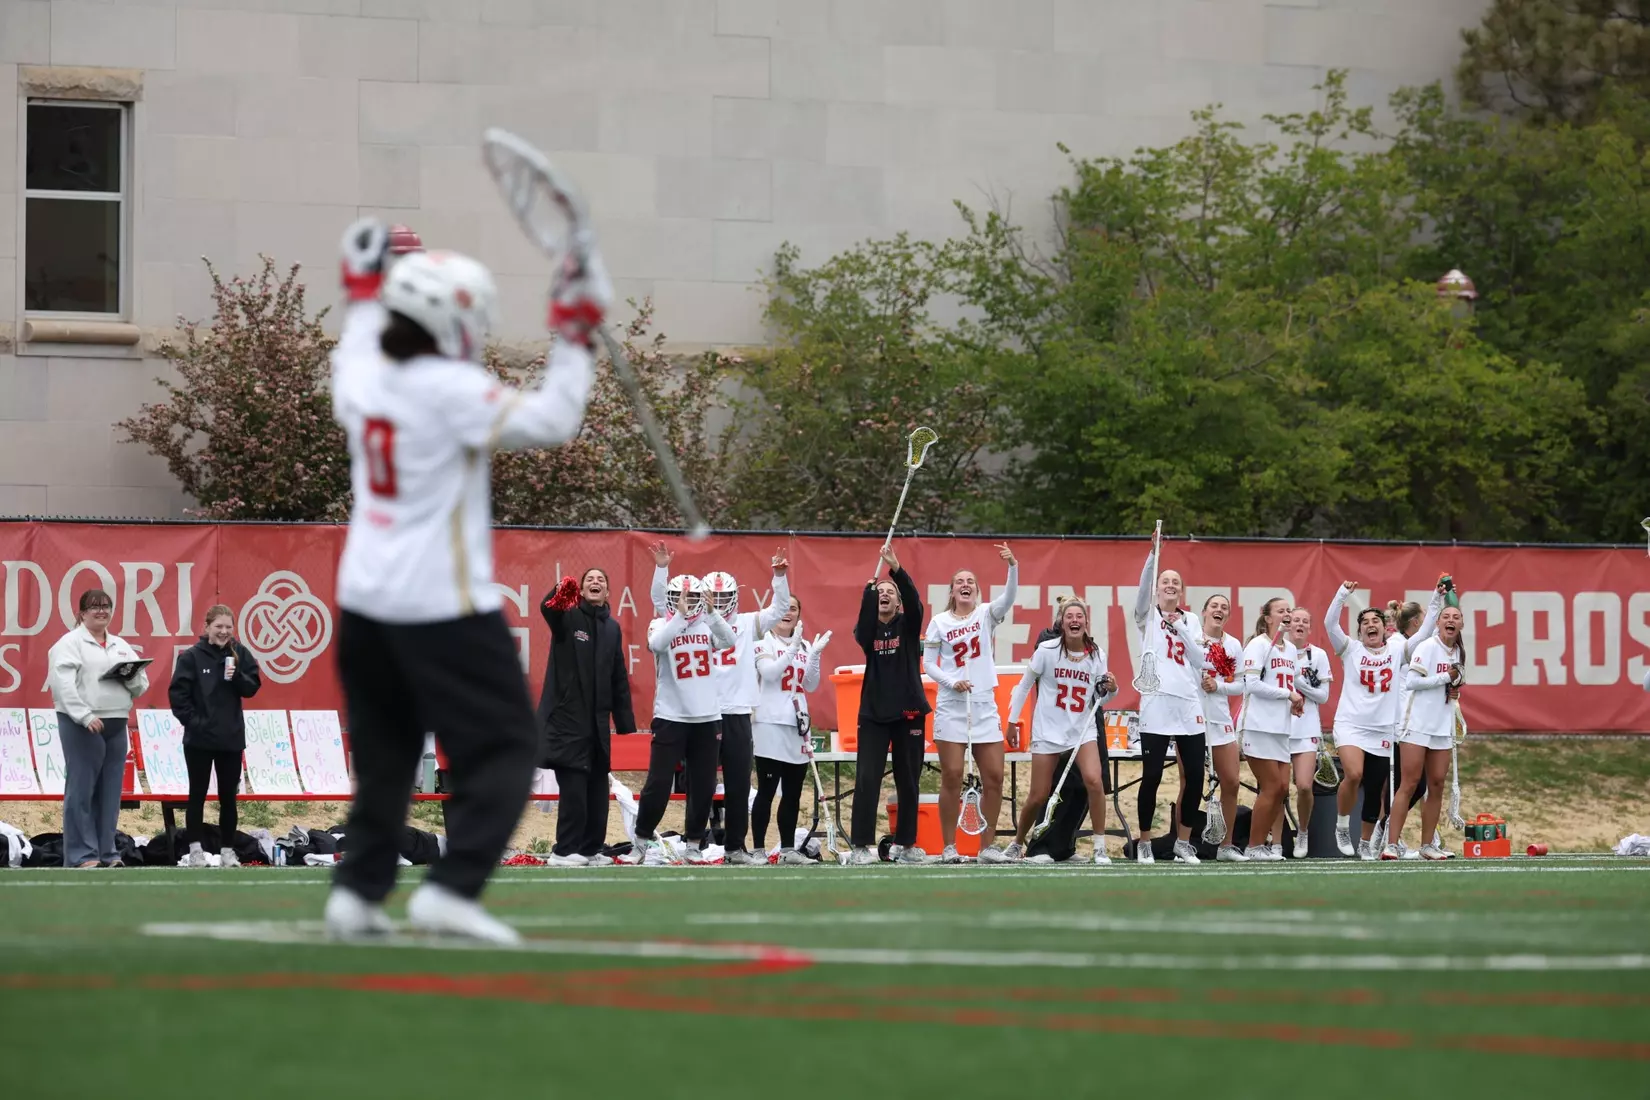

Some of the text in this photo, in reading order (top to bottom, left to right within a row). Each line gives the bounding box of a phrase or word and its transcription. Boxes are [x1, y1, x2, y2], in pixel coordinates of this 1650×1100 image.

[1, 560, 195, 637] DORI
[670, 634, 709, 649] DENVER
[947, 622, 981, 642] DENVER
[1343, 588, 1650, 685] CRO
[711, 645, 737, 666] 2
[1165, 635, 1184, 666] 13
[675, 650, 710, 679] 23
[1054, 668, 1090, 685] DENVER
[1276, 673, 1293, 692] 15
[1360, 668, 1393, 694] 42
[1056, 684, 1087, 713] 25
[1473, 844, 1482, 857] G
